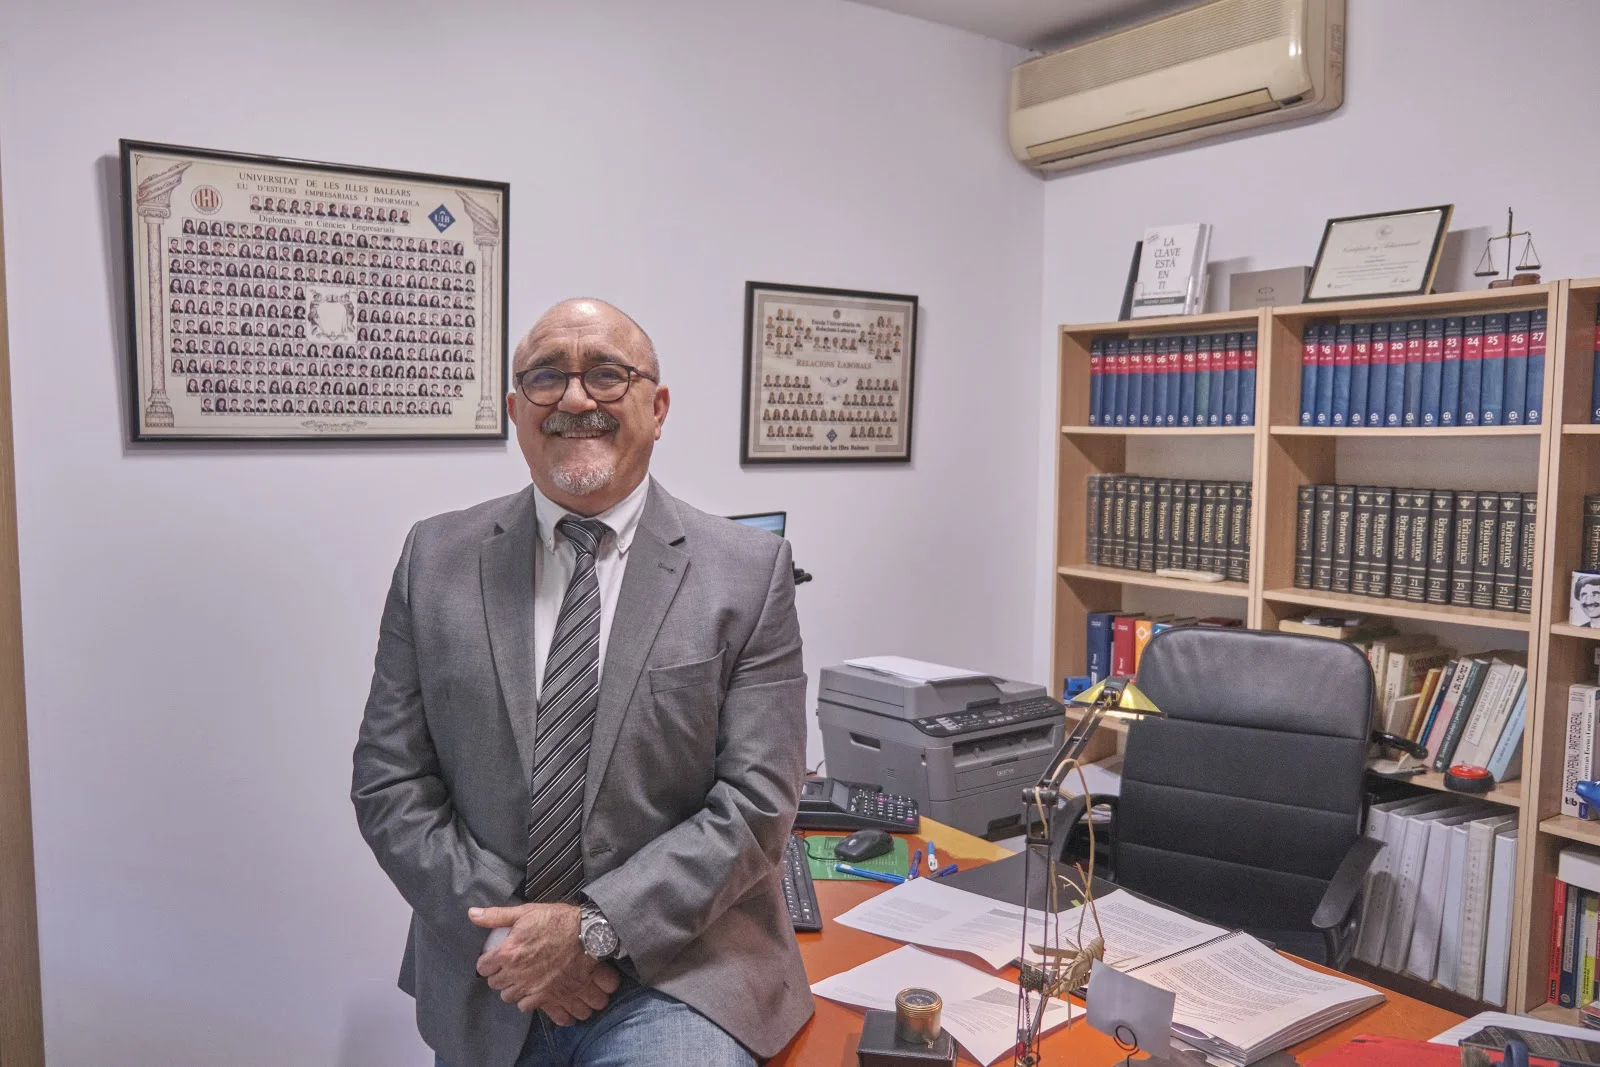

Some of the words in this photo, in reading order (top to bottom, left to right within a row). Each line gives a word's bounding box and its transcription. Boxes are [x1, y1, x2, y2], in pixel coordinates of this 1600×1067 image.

[239, 172, 299, 186] UNIVERSITAT
[306, 179, 318, 188] DE
[324, 181, 340, 190] LES
[345, 184, 368, 193] ILLES
[374, 186, 411, 197] BALEARS
[305, 190, 358, 201] EMPRESARIALS
[259, 214, 296, 225] Diplomats
[351, 223, 395, 234] Empresarials
[434, 214, 450, 223] UIB
[1163, 237, 1175, 246] LA
[1154, 248, 1181, 258] CLAVE
[1158, 270, 1170, 279] EN
[1158, 281, 1165, 290] TI
[1447, 338, 1457, 347] 23
[1467, 337, 1479, 346] 24
[1488, 336, 1498, 345] 25
[1511, 335, 1524, 344] 26
[1532, 332, 1544, 341] 27
[1306, 345, 1314, 354] 15
[1322, 346, 1330, 354] 16
[1339, 345, 1347, 353] 17
[1357, 344, 1366, 352] 18
[1374, 343, 1383, 351] 19
[1159, 502, 1167, 540] Britannica
[1174, 503, 1182, 540] Britannica
[1189, 503, 1197, 542] Britannica
[1204, 504, 1213, 543] Britannica
[1217, 504, 1226, 543] Britannica
[1234, 505, 1243, 544] Britannica
[1321, 510, 1330, 552] Britannica
[1339, 512, 1349, 554] Britannica
[1359, 513, 1369, 556] Britannica
[1376, 514, 1387, 557] Britannica
[1398, 515, 1409, 559] Britannica
[1415, 517, 1426, 561] Britannica
[1436, 518, 1448, 564] Britannica
[1460, 518, 1472, 564] Britannica
[1482, 520, 1494, 566] Britannica
[1504, 521, 1516, 568] Britannica
[1478, 584, 1486, 592] 24
[1522, 589, 1531, 597] 26
[1467, 714, 1481, 740] TRABAJO
[1569, 712, 1582, 735] GENERAL
[1568, 735, 1580, 751] PARTE
[1567, 754, 1579, 769] PENAL
[1566, 770, 1577, 793] DERECHO
